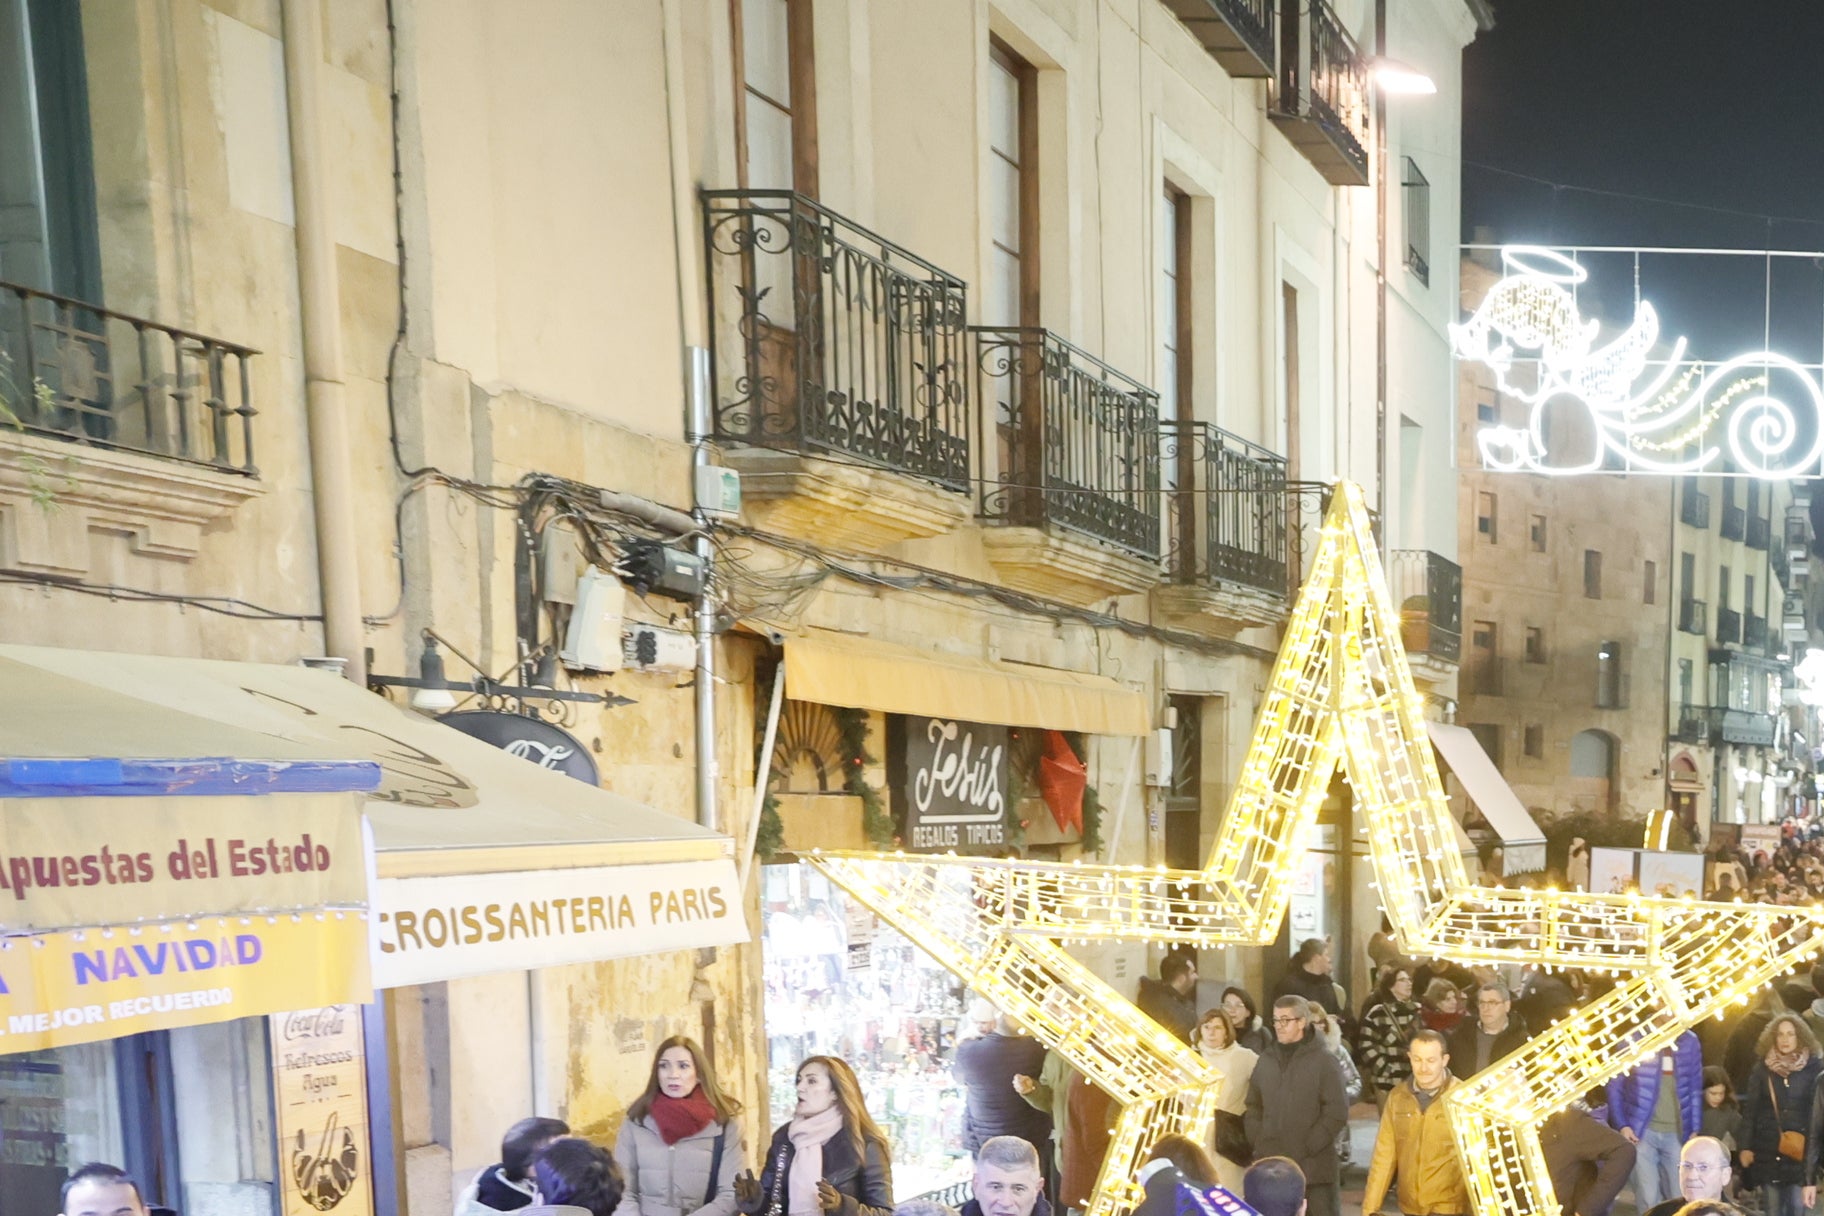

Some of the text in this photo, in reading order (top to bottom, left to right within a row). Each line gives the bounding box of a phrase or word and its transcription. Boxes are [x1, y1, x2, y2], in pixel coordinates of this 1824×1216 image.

[915, 719, 1004, 818] Jesús
[168, 838, 220, 881] del
[228, 833, 331, 877] Estado
[913, 825, 958, 848] REGALOS
[650, 886, 727, 925] PARIS
[72, 934, 263, 985] NAVIDAD
[9, 987, 233, 1035] MEJOR RECUERDO
